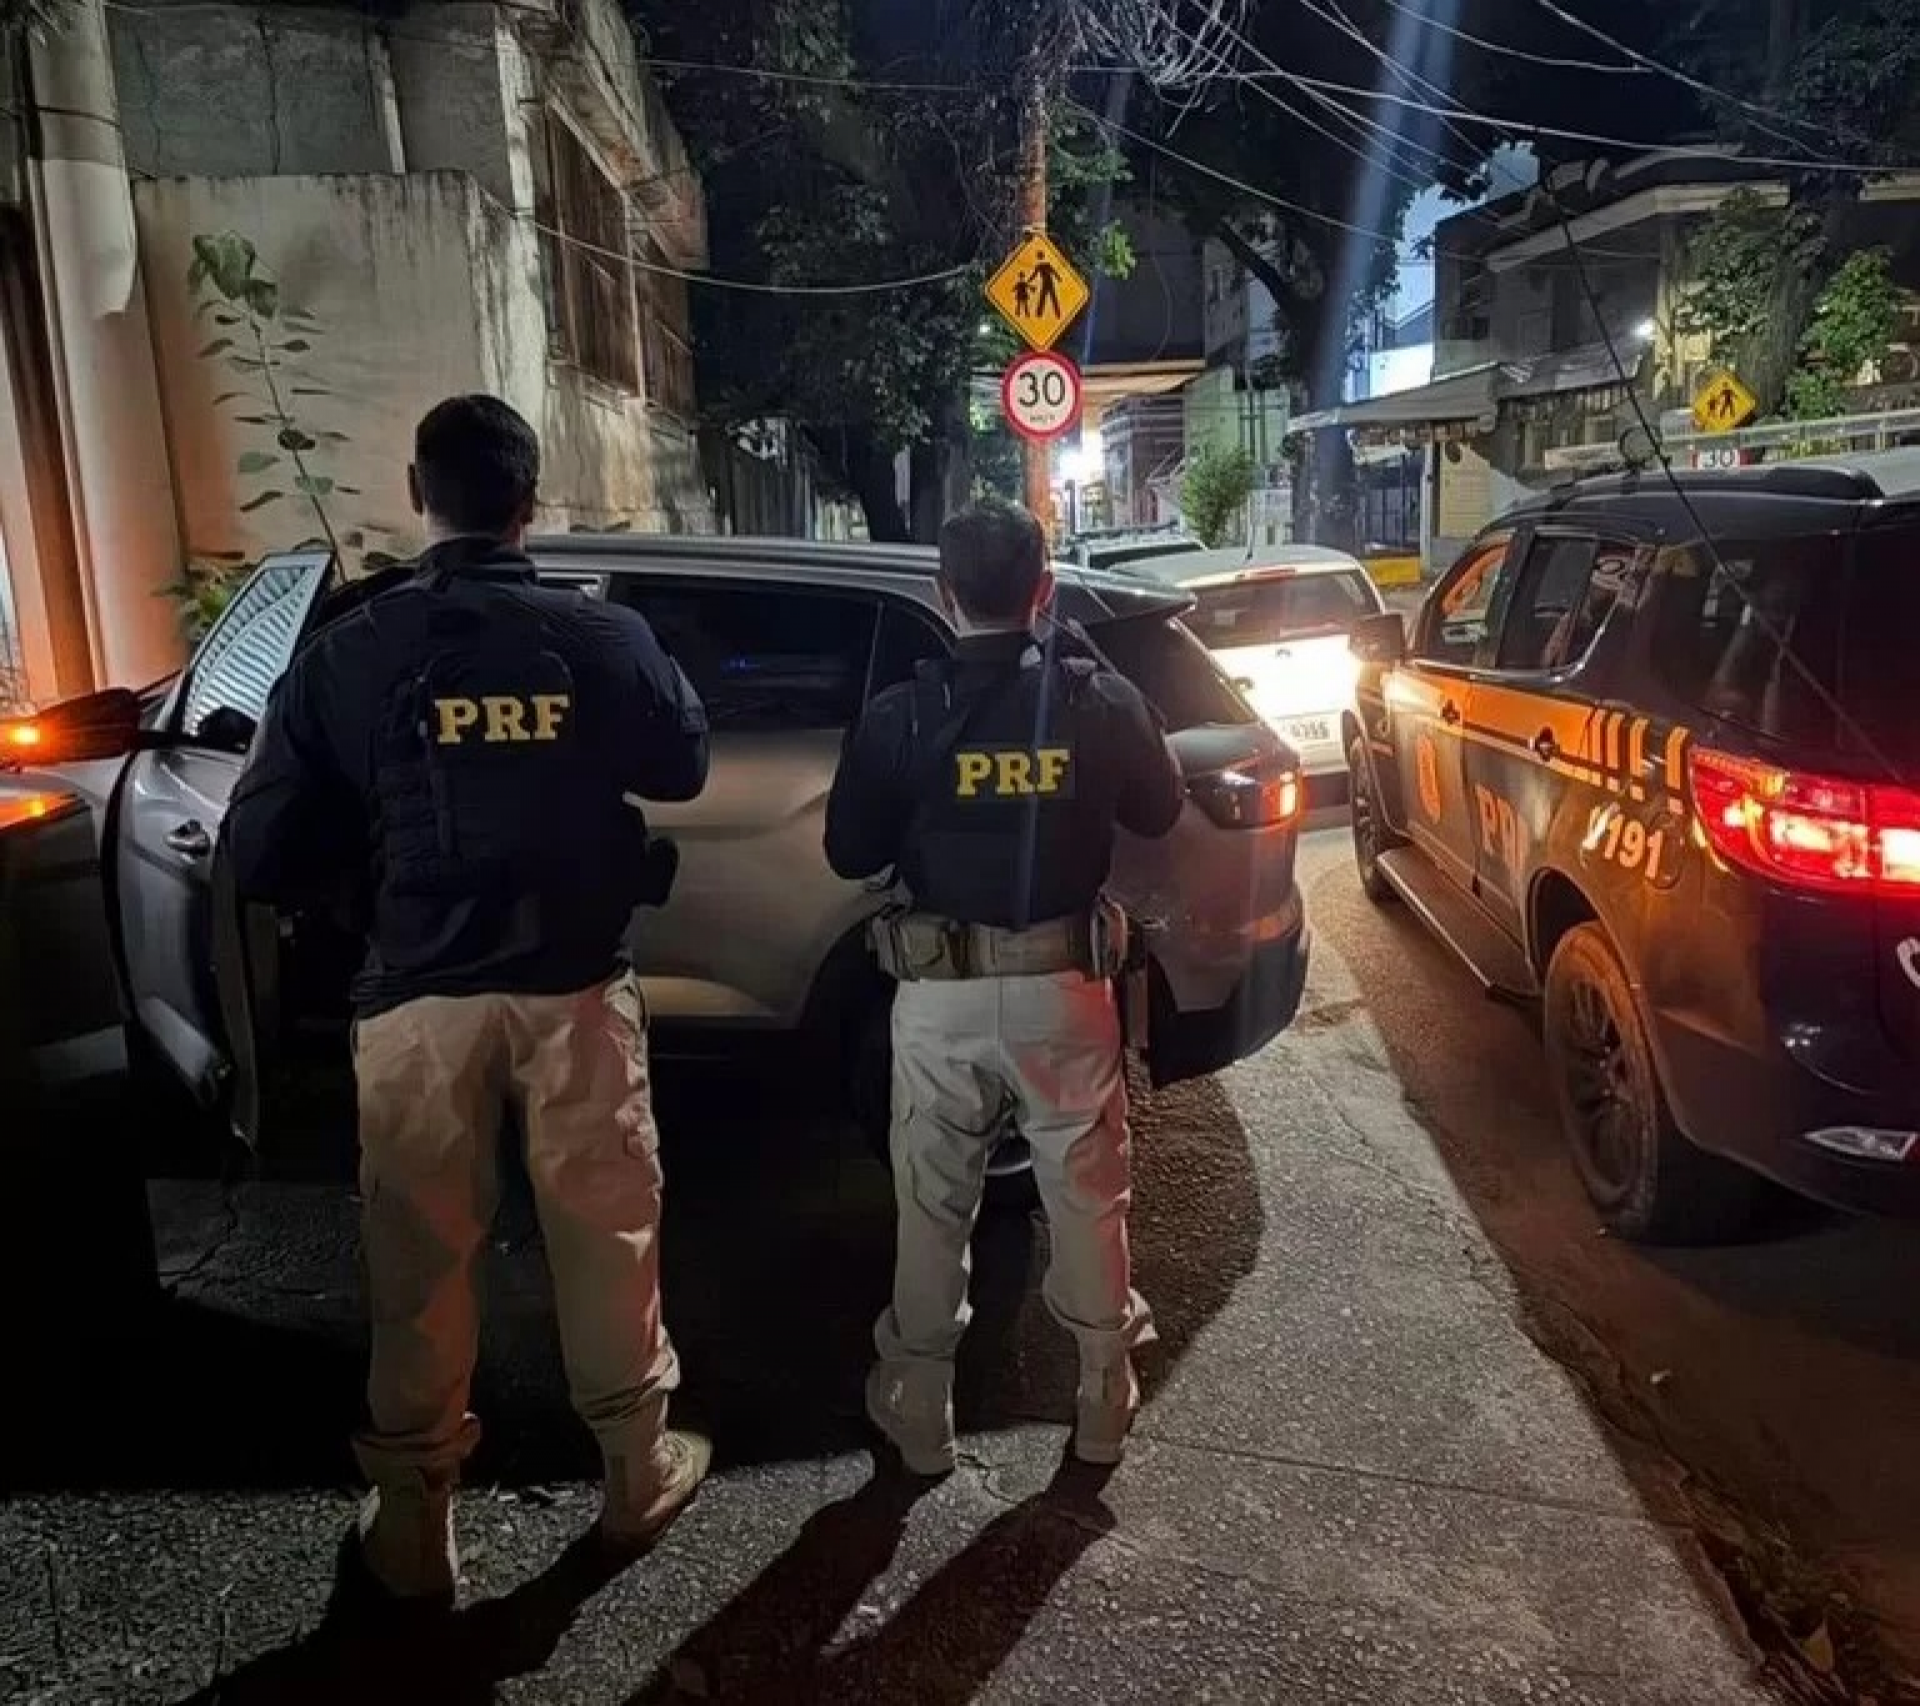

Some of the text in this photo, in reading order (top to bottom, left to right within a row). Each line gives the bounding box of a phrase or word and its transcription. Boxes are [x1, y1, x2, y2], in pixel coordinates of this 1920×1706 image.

[1019, 371, 1066, 407] 30
[435, 693, 571, 744] PRF
[954, 748, 1071, 796] PRF
[1602, 813, 1664, 880] 191
